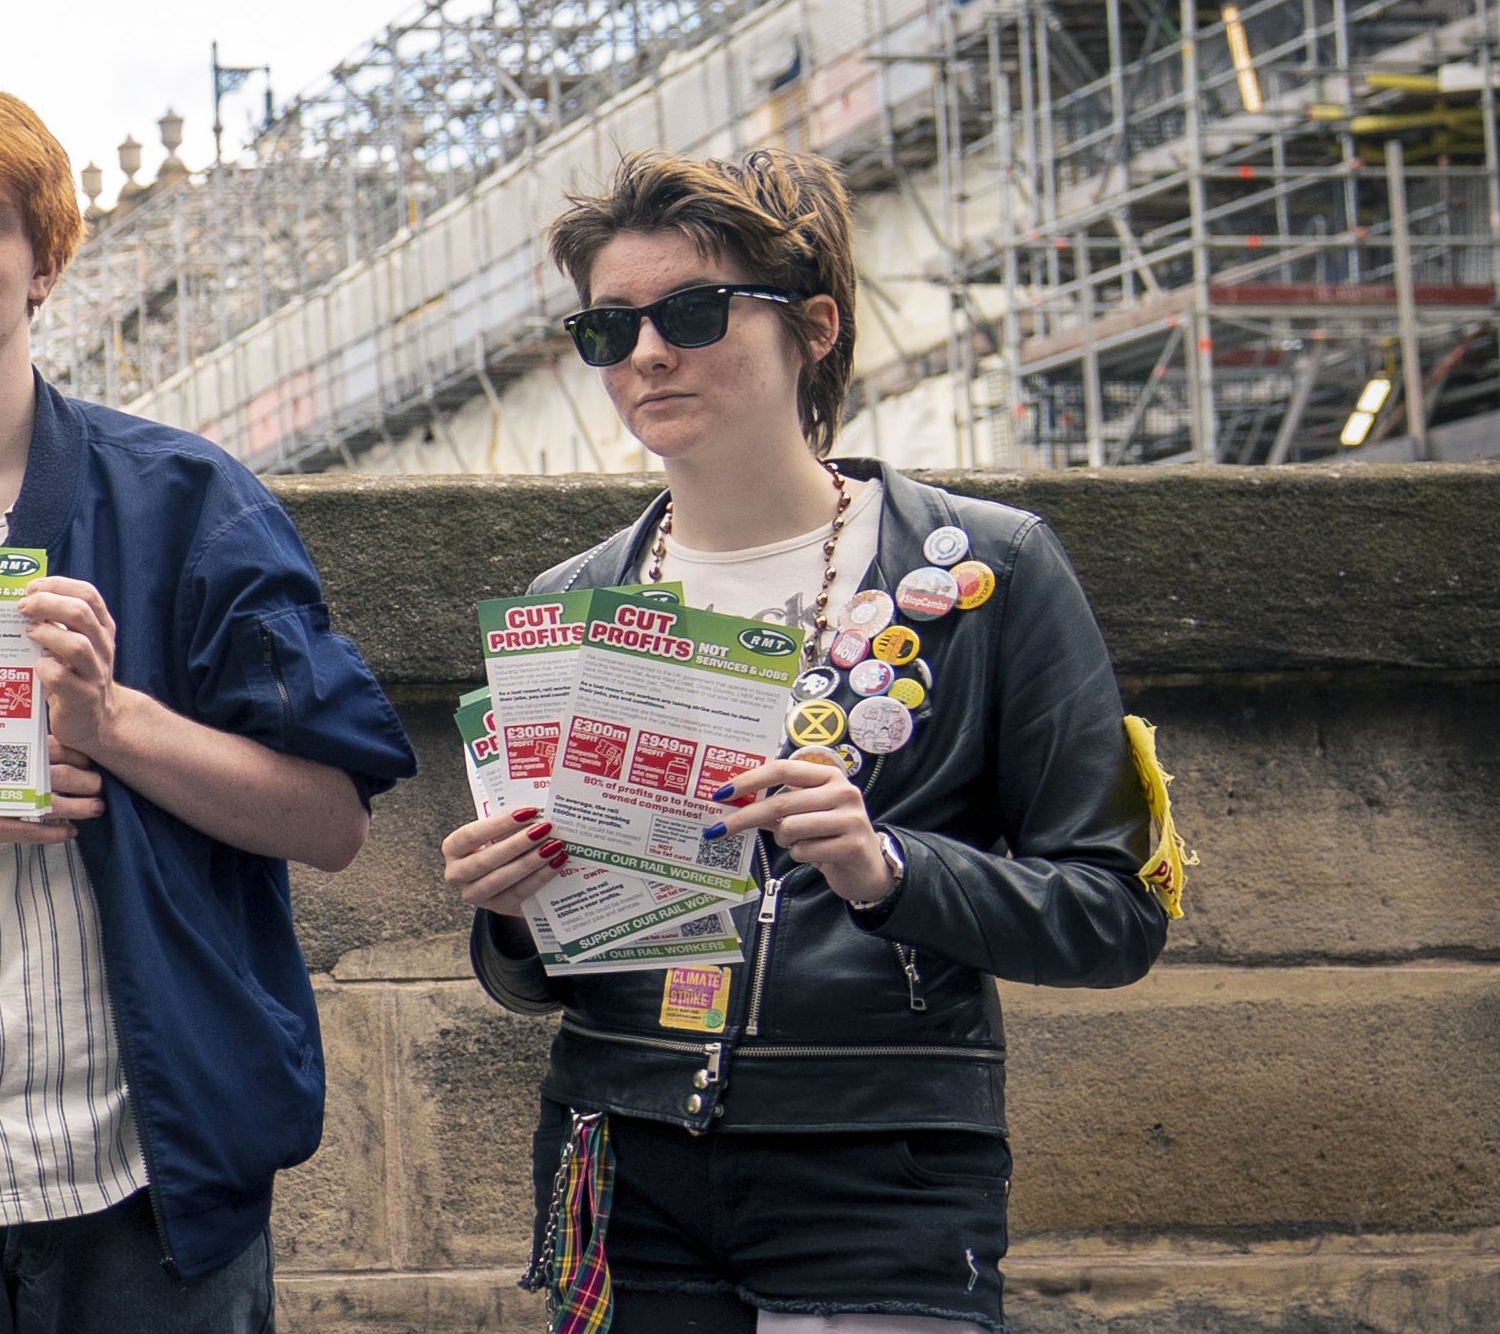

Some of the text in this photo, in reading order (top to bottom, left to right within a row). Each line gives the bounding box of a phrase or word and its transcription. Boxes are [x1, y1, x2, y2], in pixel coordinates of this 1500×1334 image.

[0, 559, 32, 570] RMT
[508, 605, 560, 629] CUT
[617, 606, 787, 650] CUT RMT
[489, 624, 584, 651] PROFITS
[591, 622, 730, 659] PROFITS NOT
[695, 655, 749, 675] SERVICES
[758, 666, 789, 682] JOBS
[506, 725, 560, 739] £300m
[573, 719, 628, 742] £300m
[639, 733, 696, 755] £949m
[706, 747, 762, 768] £235m
[583, 775, 723, 815] 80% of profits go to foreign
[601, 791, 703, 820] owned companies!
[611, 853, 639, 868] OUR
[639, 859, 667, 875] RAIL
[670, 866, 733, 890] WORKERS
[579, 923, 631, 950] SUPPORT
[632, 913, 658, 929] OUR
[659, 904, 685, 921] RAIL
[609, 941, 726, 960] OUR RAIL WORKERS
[672, 970, 721, 988] CLIMATE
[670, 989, 710, 1007] STRIKE
